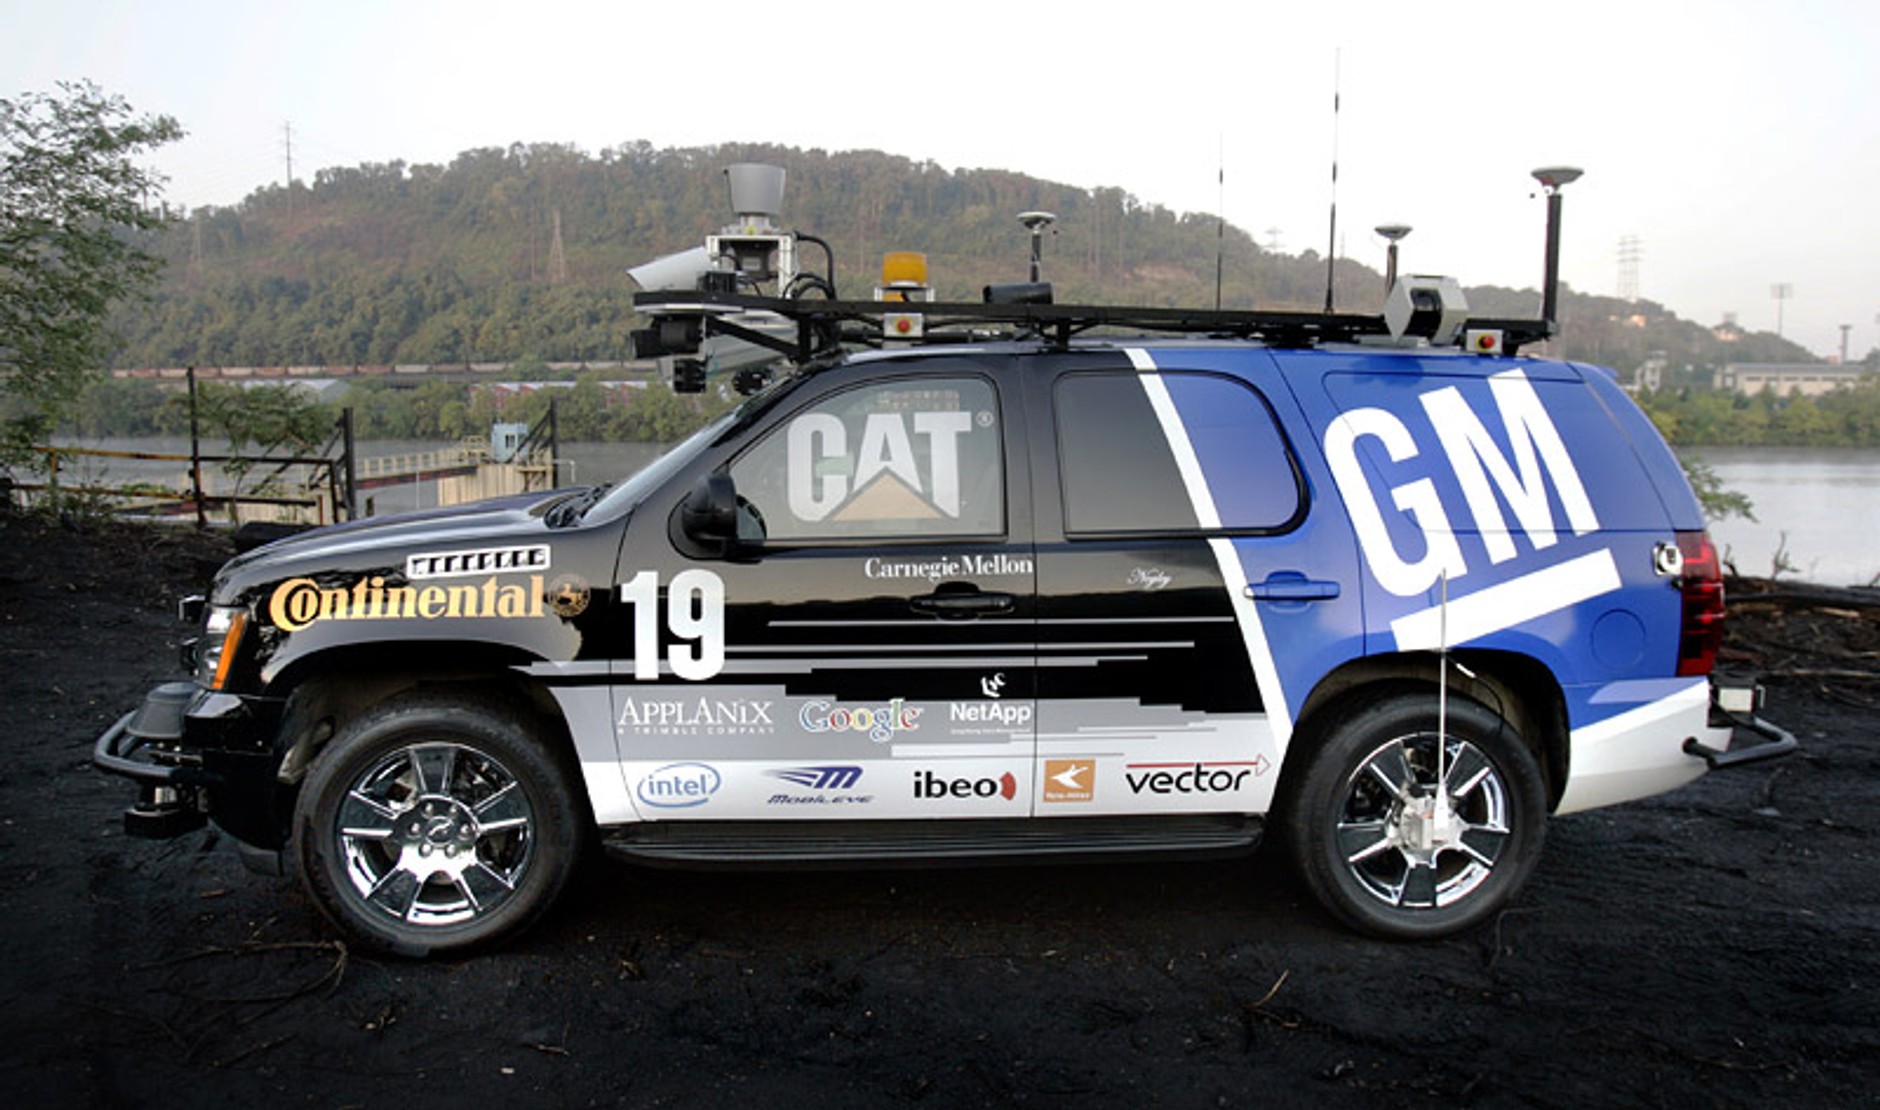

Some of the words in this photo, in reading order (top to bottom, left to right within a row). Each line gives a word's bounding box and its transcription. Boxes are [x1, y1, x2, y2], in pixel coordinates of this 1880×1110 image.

[787, 411, 973, 523] CAT
[1323, 368, 1600, 597] GM
[864, 556, 961, 581] Carnegie
[960, 553, 1034, 575] Mellon
[268, 575, 546, 632] Continental
[621, 568, 726, 681] 19
[799, 697, 924, 742] Google
[950, 702, 1032, 725] NetApp
[649, 774, 707, 796] intel
[914, 771, 998, 799] ibeo
[1126, 763, 1251, 795] vector
